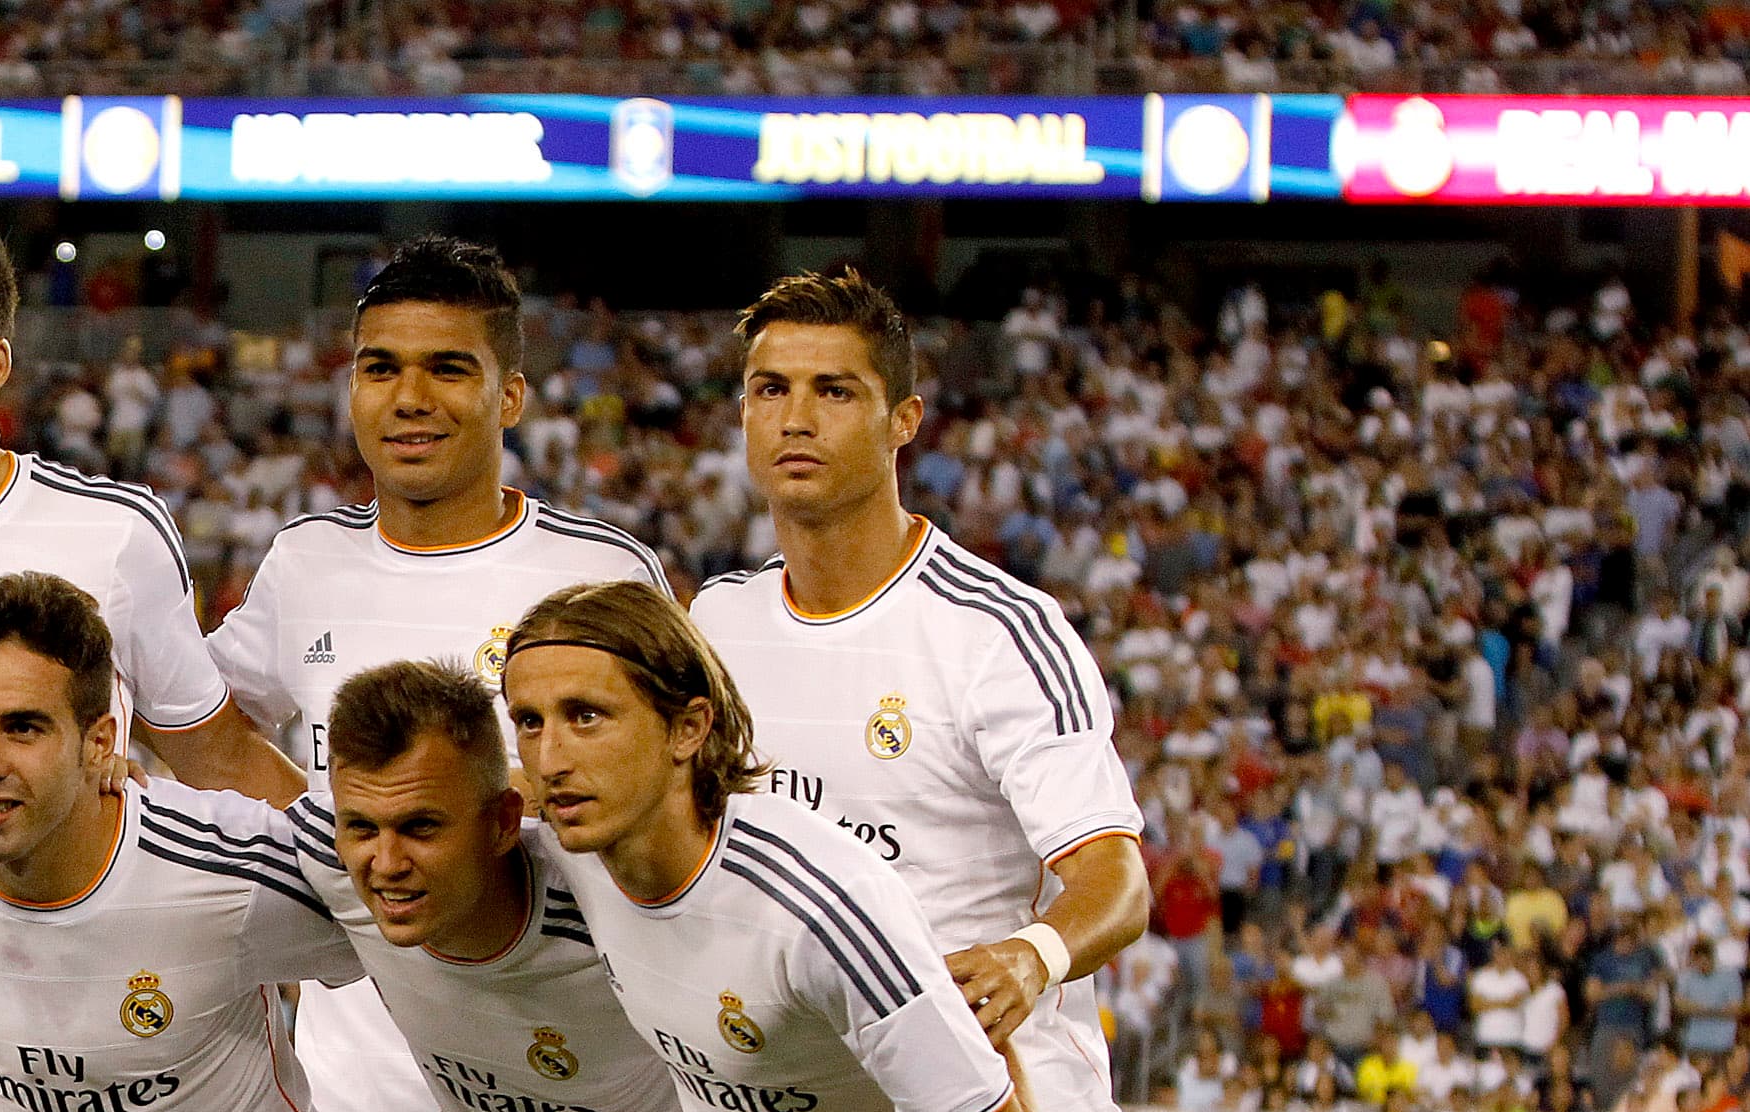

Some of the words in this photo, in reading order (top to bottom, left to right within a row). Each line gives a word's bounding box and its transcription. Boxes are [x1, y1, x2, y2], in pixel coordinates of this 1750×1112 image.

[303, 651, 336, 664] adidas
[770, 769, 823, 811] Fly
[16, 1046, 85, 1083] Fly
[653, 1028, 715, 1074] Fly
[431, 1054, 497, 1090] Fly
